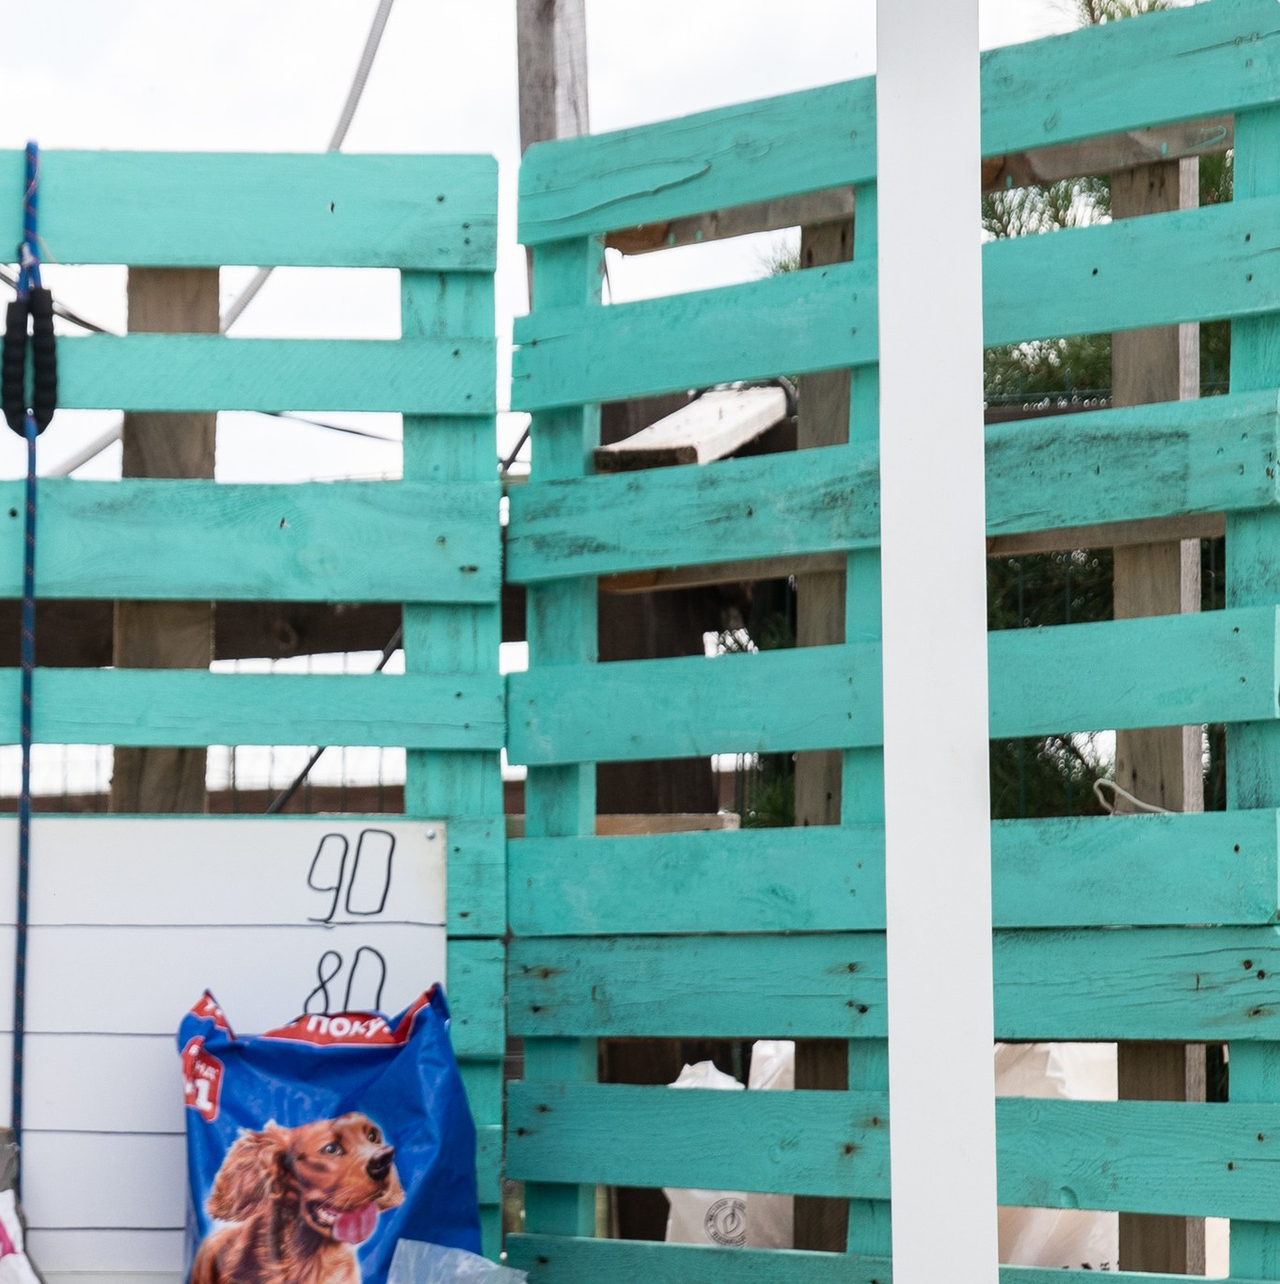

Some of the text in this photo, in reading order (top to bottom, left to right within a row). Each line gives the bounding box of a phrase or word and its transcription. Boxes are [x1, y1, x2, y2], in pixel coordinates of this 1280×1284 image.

[307, 827, 396, 924] 90
[304, 945, 386, 1015] 80
[305, 1016, 391, 1037] ПОКУ
